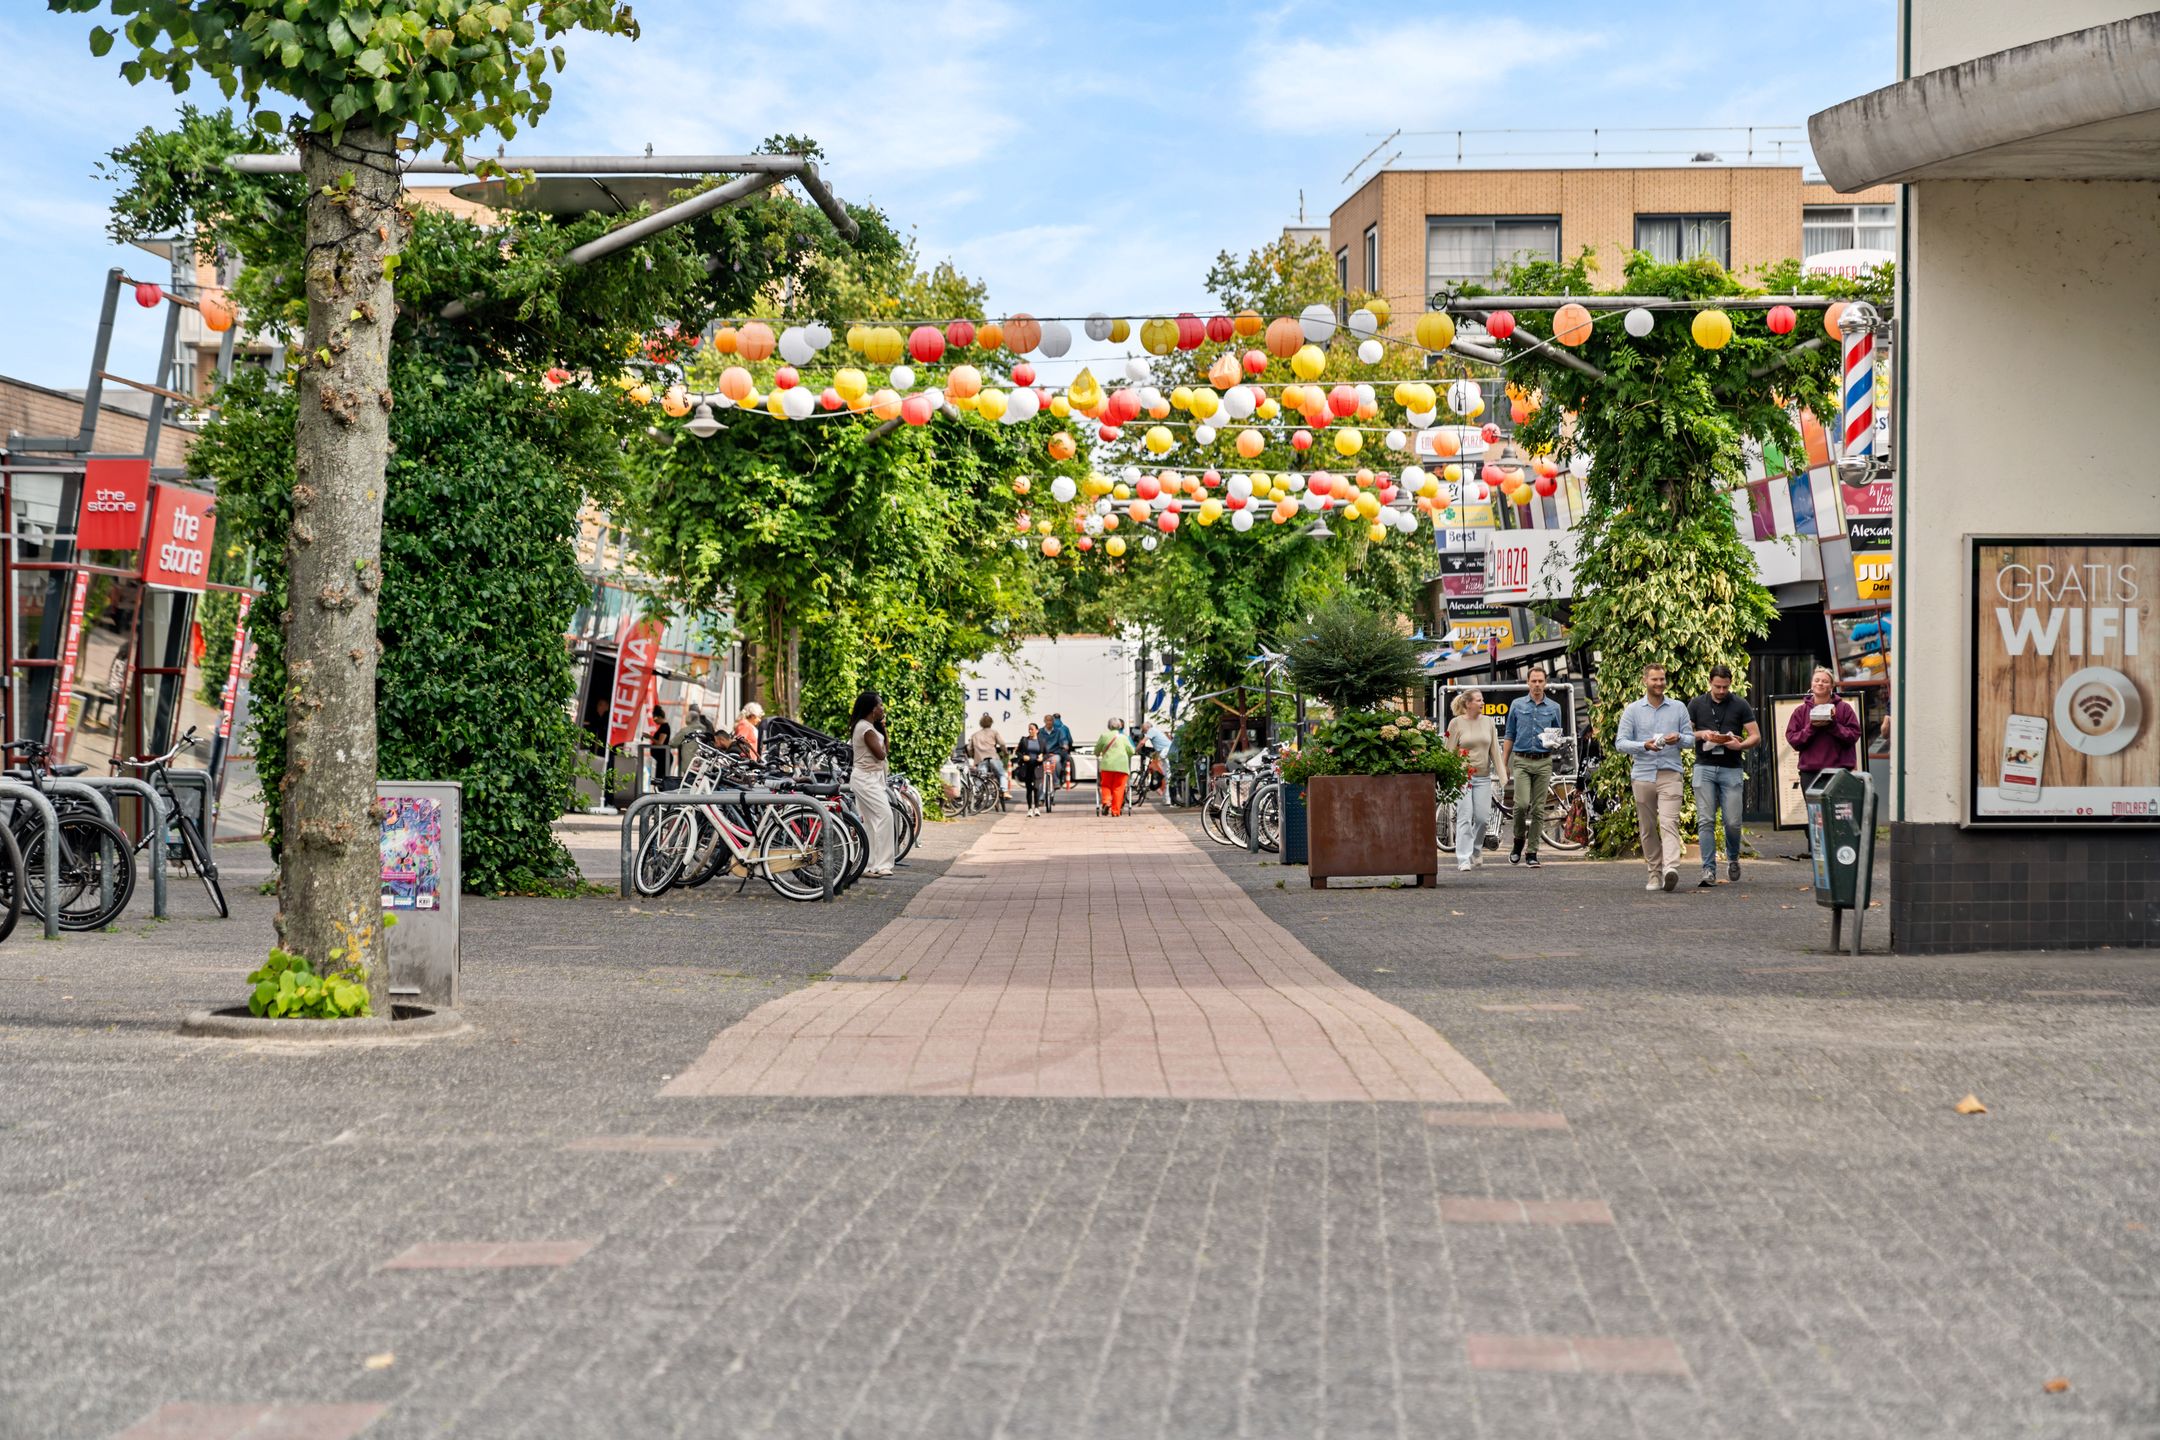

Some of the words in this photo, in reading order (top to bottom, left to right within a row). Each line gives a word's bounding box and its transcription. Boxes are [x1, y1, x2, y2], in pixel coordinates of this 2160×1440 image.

[87, 501, 137, 512] stone
[96, 489, 126, 501] the
[173, 505, 200, 541] the
[160, 540, 203, 575] stone
[1496, 547, 1528, 588] PLAZA
[1873, 584, 1890, 592] Den
[1996, 564, 2139, 602] GRATIS
[1995, 607, 2139, 656] WIFI
[611, 638, 651, 730] HEMA
